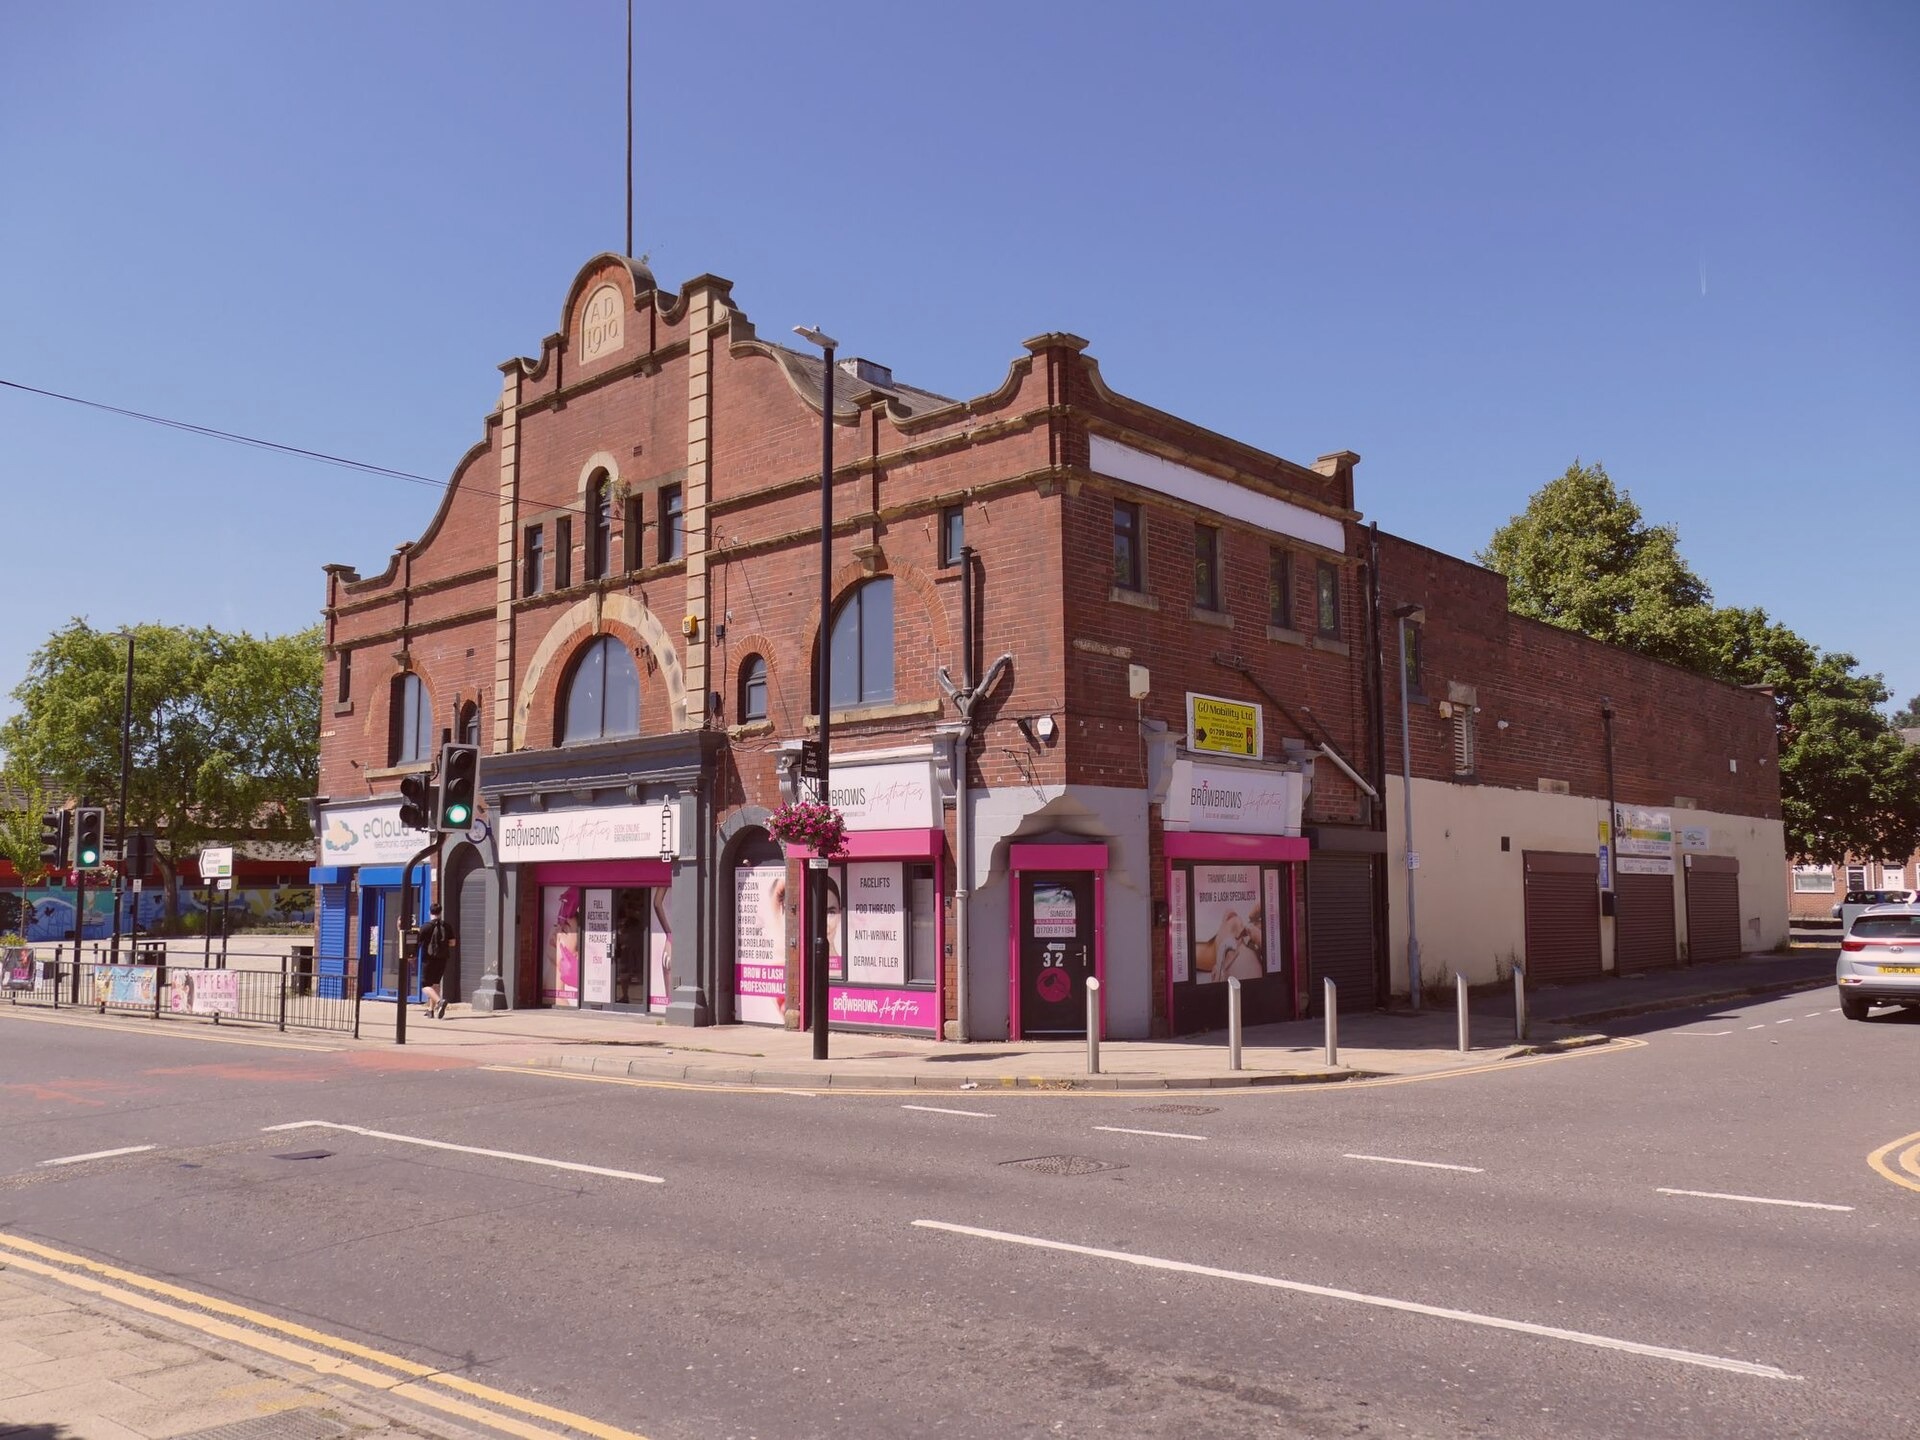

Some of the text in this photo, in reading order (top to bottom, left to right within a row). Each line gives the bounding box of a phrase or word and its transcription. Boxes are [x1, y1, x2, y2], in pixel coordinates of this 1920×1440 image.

[1197, 701, 1209, 713] GO
[1210, 705, 1240, 720] Mobility
[1241, 710, 1253, 721] Ltd
[1209, 727, 1225, 736] 01709
[1190, 787, 1243, 809] BROWBROWS
[626, 823, 640, 833] ONLINE
[505, 825, 560, 848] BROWBROWS
[737, 881, 760, 891] RUSSIAN
[859, 877, 891, 888] FACELIFTS
[737, 893, 760, 902] EXPRESS
[1199, 892, 1213, 902] BROW
[1218, 891, 1230, 902] LASH
[1230, 890, 1257, 901] SPECIALISTS
[593, 899, 604, 909] FULL
[737, 904, 759, 914] CLASSIC
[869, 903, 896, 914] THREADS
[587, 911, 610, 921] AESTHETIC
[737, 915, 757, 925] HYBRID
[588, 922, 609, 932] TRAINING
[746, 927, 763, 937] BROWS
[1035, 925, 1053, 934] 01709
[588, 934, 608, 943] PACKAGE
[854, 929, 898, 941] ANTI-WRINKLE
[737, 938, 775, 948] MICROBLADING
[737, 949, 774, 960] OMBRE BROWS
[1042, 951, 1064, 968] 32
[853, 955, 878, 968] DERMAL
[878, 956, 899, 968] FILLER
[743, 966, 761, 979] BROW
[767, 967, 784, 980] LASH
[832, 997, 878, 1013] BROWBROWS
